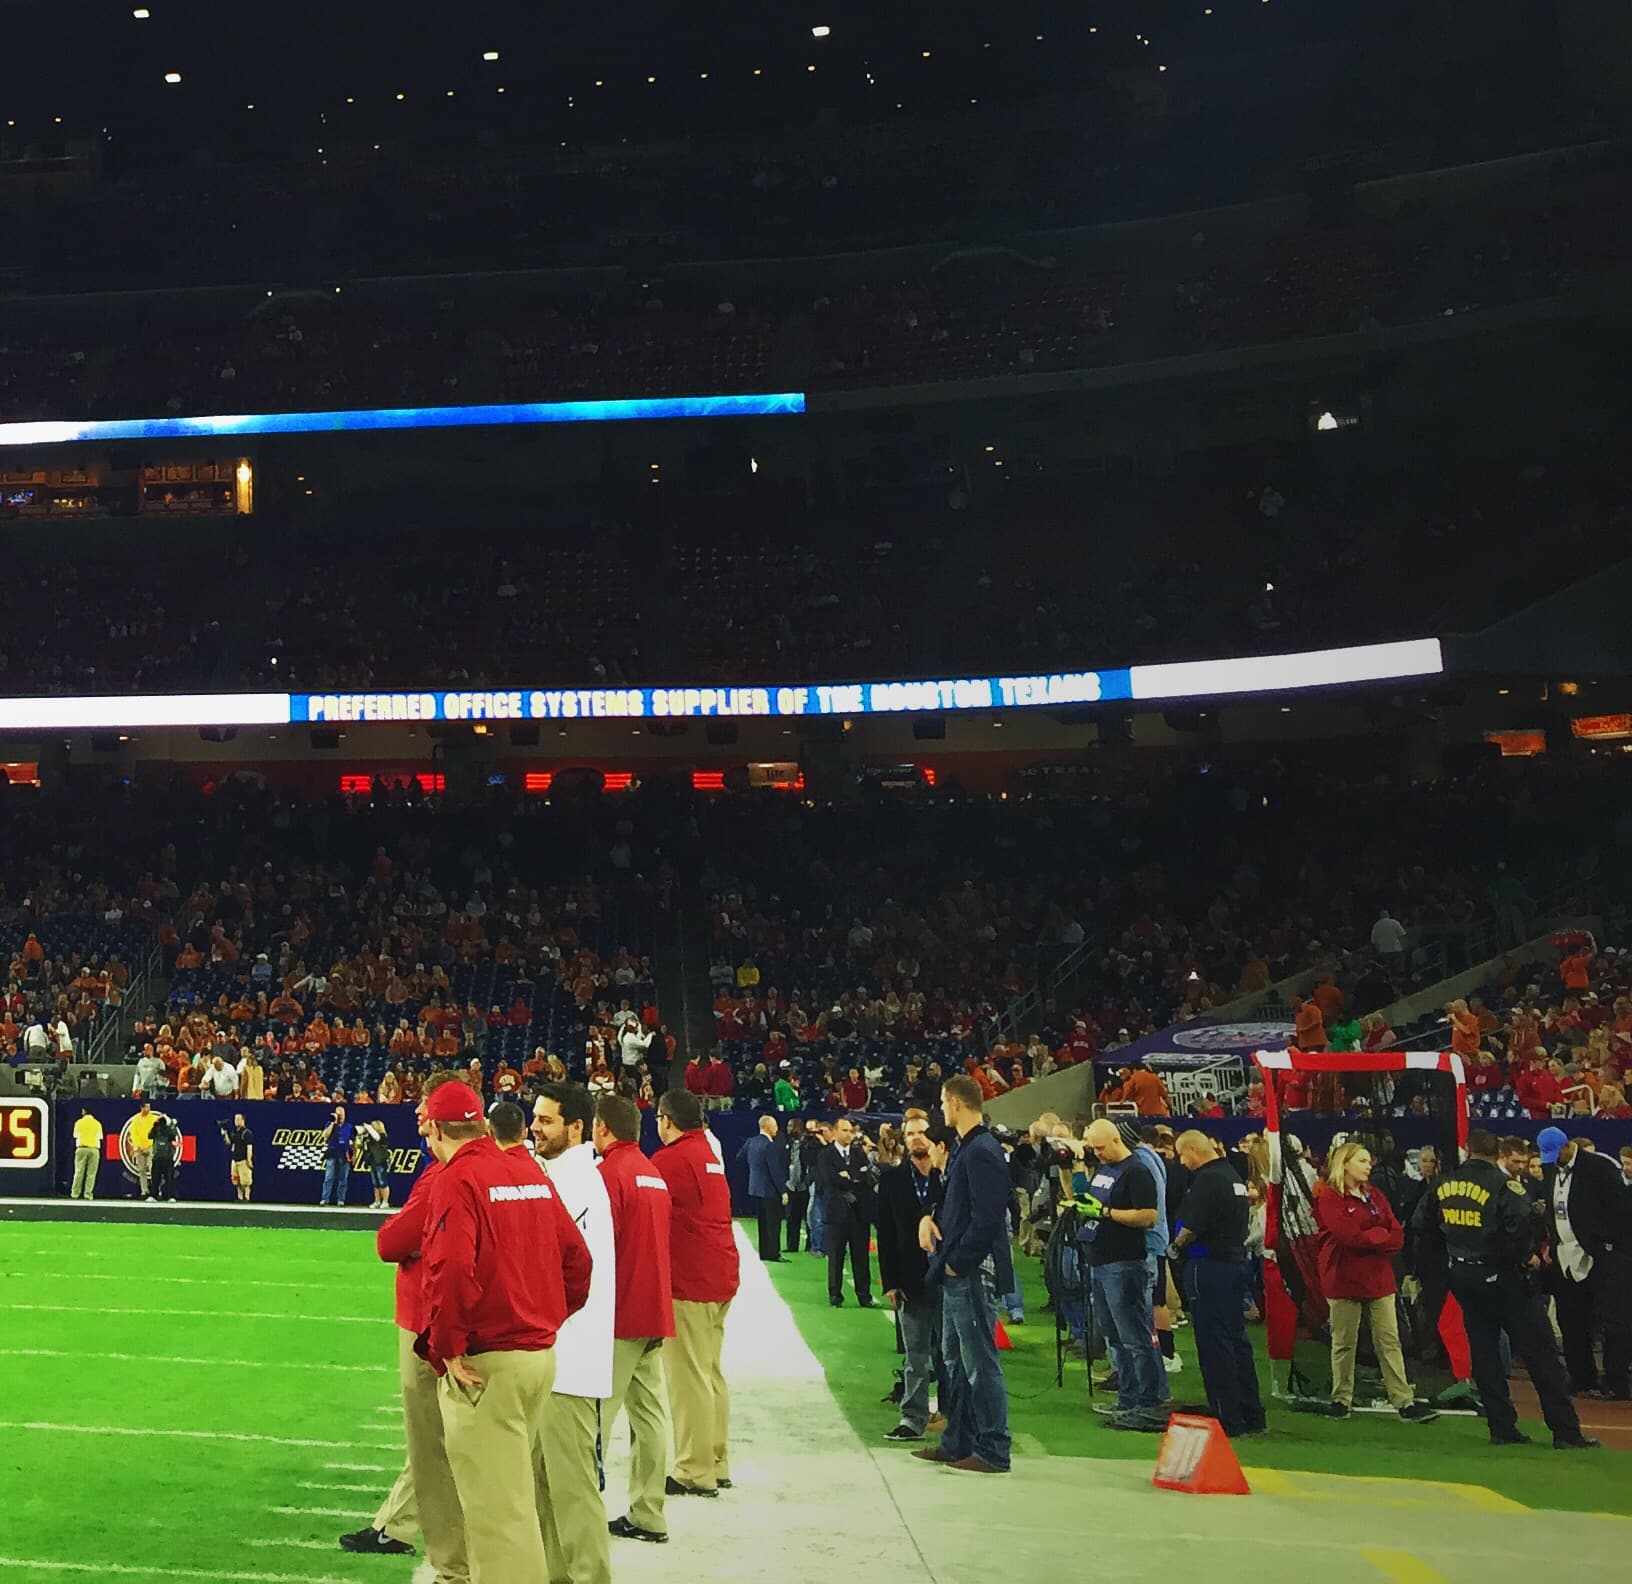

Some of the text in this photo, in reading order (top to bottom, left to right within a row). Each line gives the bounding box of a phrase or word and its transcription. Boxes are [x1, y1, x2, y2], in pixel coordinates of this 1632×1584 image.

[443, 691, 522, 719] OFFICE
[530, 689, 644, 718] SYSTEMS
[651, 687, 769, 716] SUPPLIER
[777, 687, 808, 715] OF
[815, 684, 865, 713] THE
[870, 679, 992, 711] HOUSTON
[998, 672, 1102, 706] TEXANS
[1437, 1181, 1490, 1206] HOUSTON
[1442, 1208, 1482, 1227] POLICE
